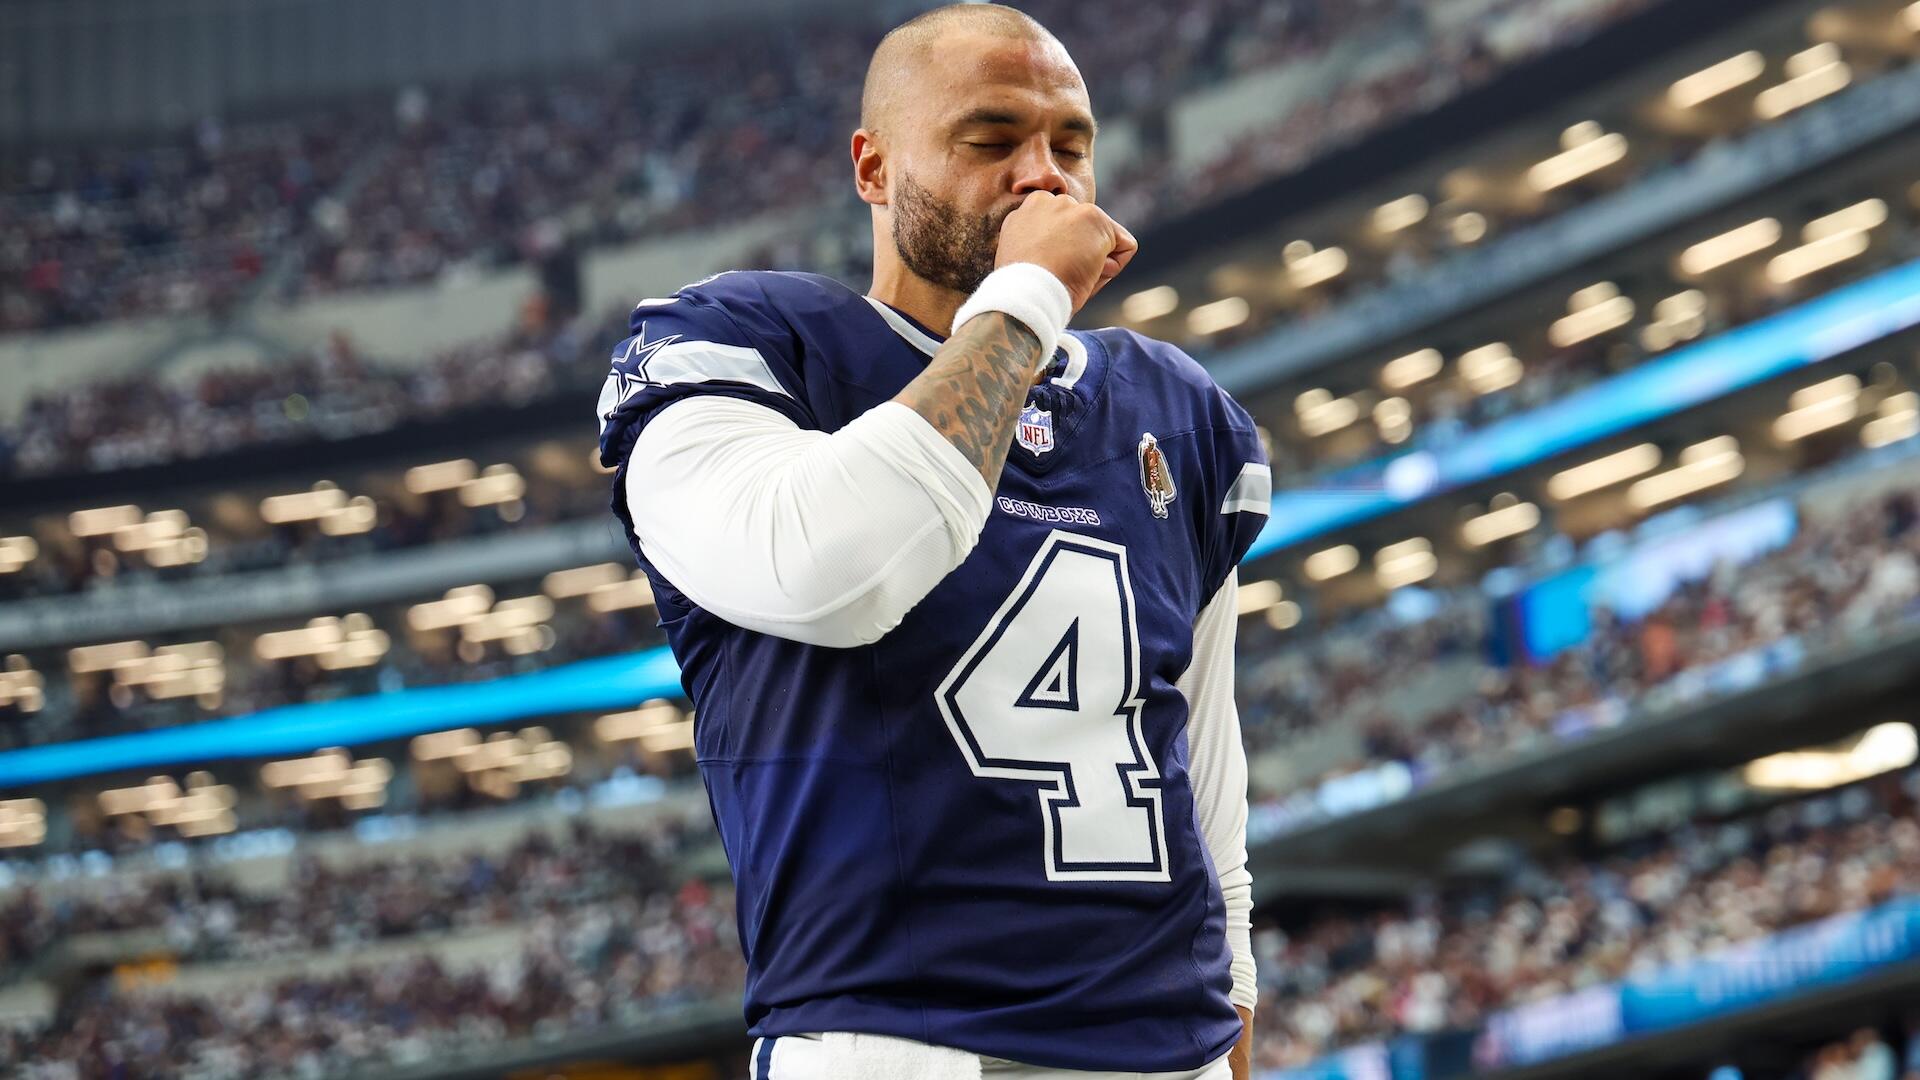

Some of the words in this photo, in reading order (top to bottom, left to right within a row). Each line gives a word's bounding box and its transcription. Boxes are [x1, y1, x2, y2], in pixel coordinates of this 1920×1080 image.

[1023, 425, 1049, 446] NFL
[997, 496, 1101, 526] COWBOYS
[934, 529, 1172, 882] 4
